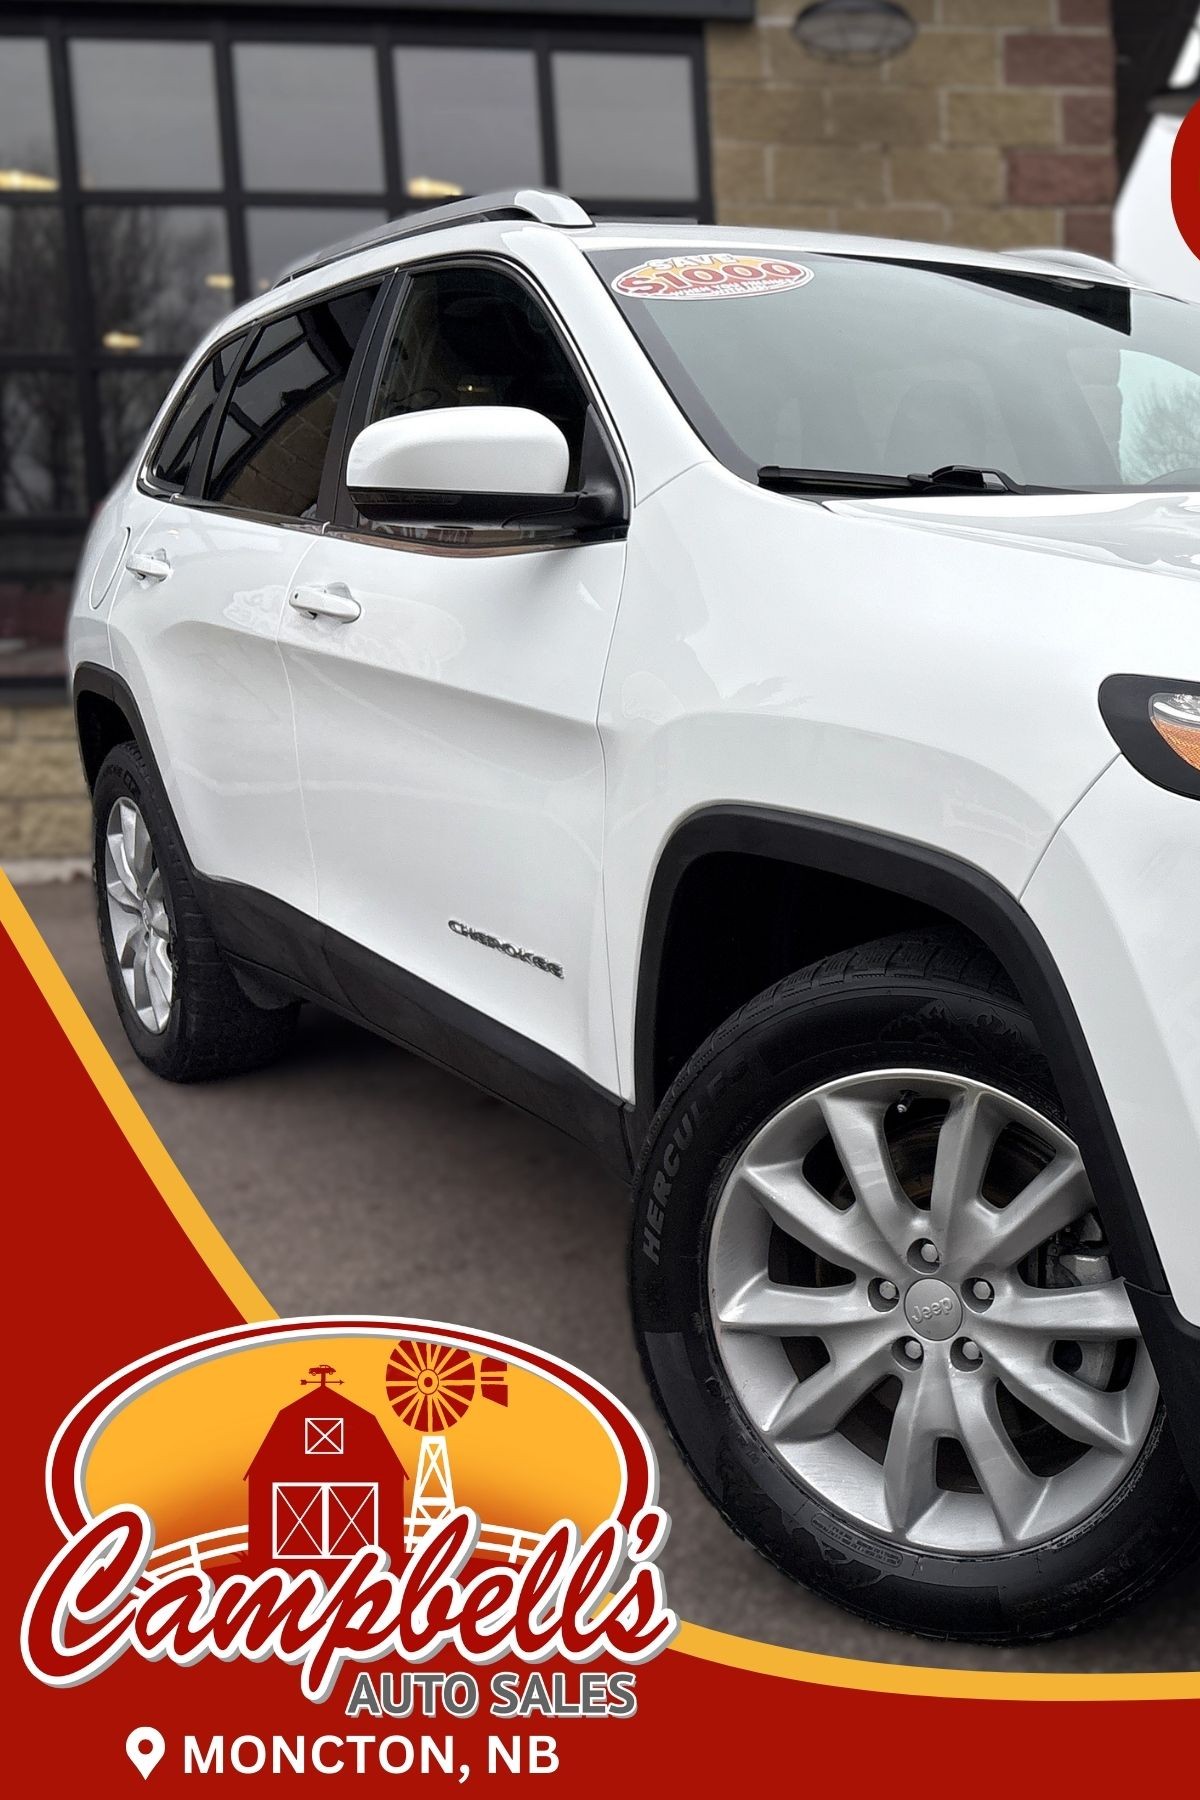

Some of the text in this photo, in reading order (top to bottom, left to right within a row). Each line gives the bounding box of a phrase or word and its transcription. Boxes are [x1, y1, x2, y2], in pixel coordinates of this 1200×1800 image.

[651, 254, 739, 270] SAVE
[619, 262, 803, 294] $1000
[447, 919, 565, 980] CHEROKEE
[911, 1296, 954, 1325] Jeep
